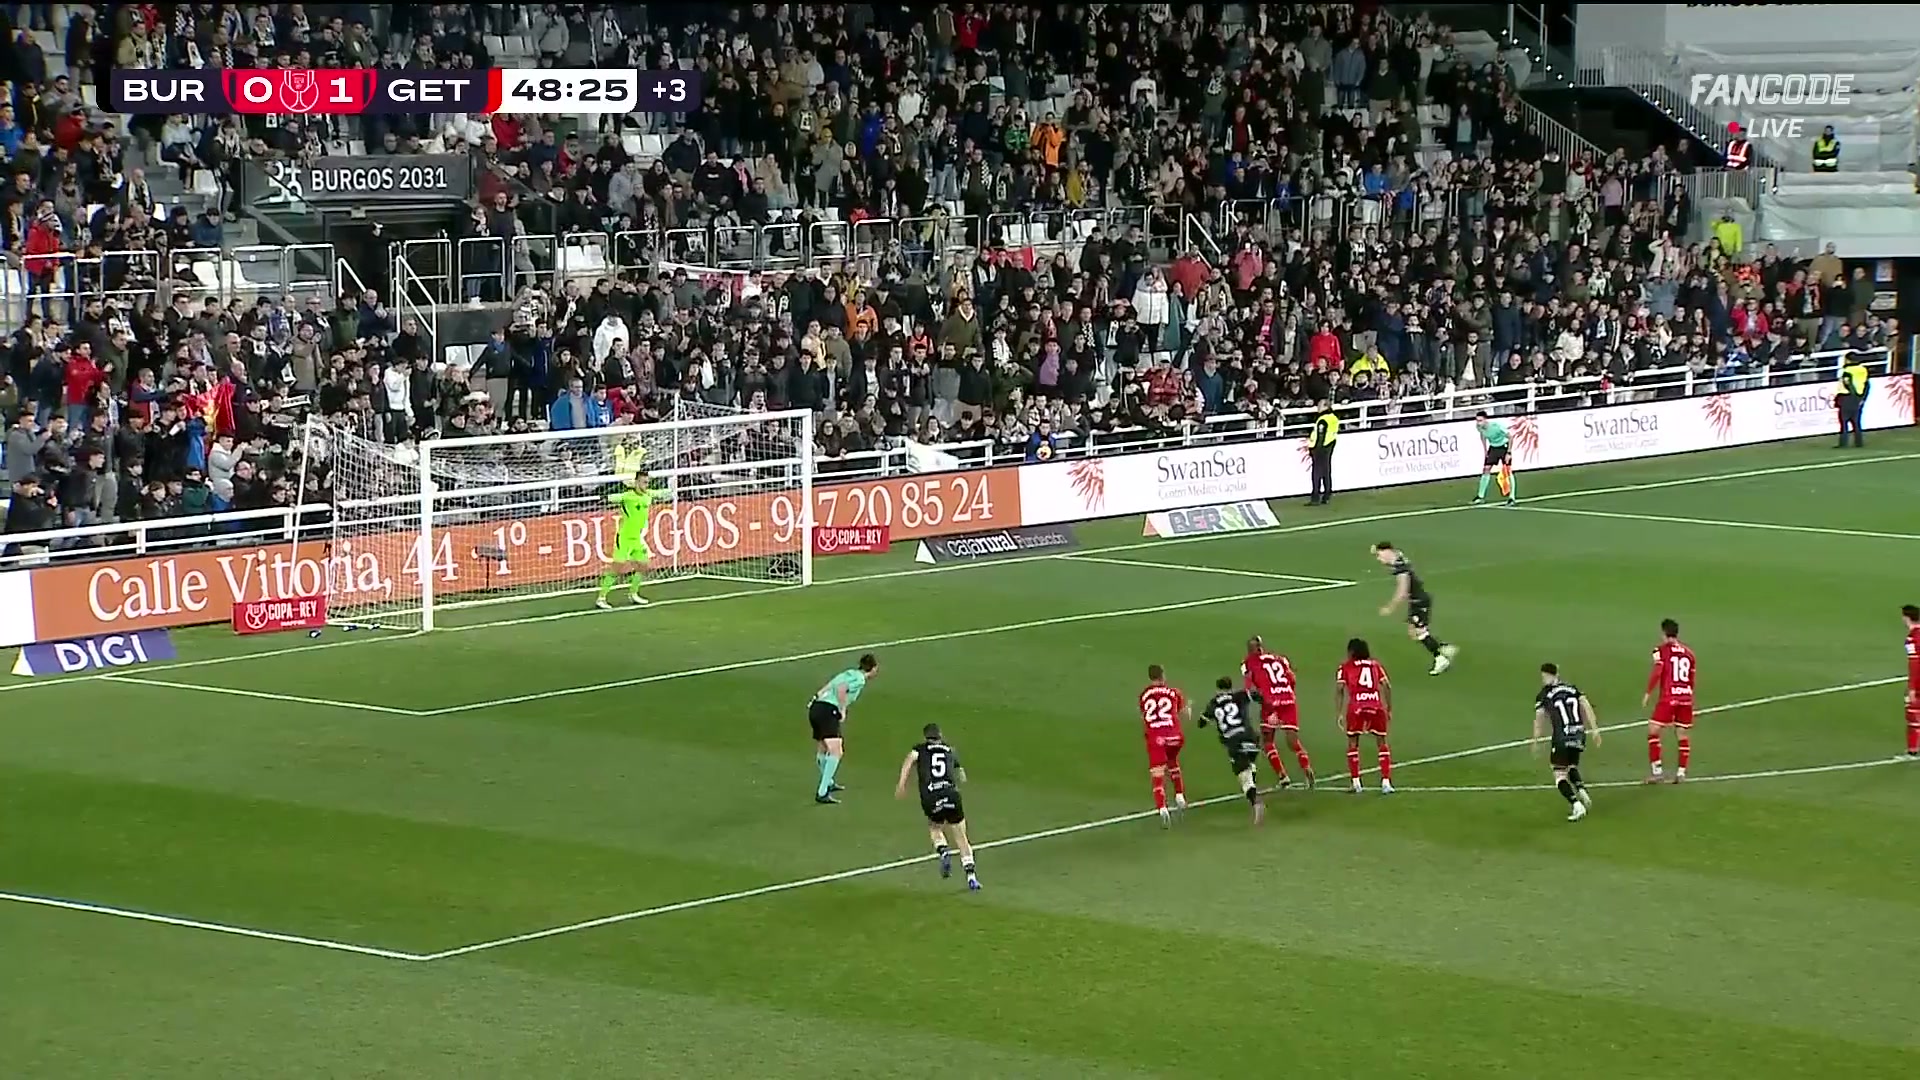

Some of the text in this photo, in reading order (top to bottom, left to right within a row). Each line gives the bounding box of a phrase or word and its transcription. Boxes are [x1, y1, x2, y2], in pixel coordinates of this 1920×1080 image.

[311, 167, 447, 191] BURGOS 2031
[1773, 386, 1835, 416] SwanSe
[1583, 408, 1658, 438] SwanSea
[1377, 428, 1459, 460] SwanSea
[1157, 450, 1246, 483] SwanSea
[87, 558, 209, 623] Calle
[216, 539, 392, 604] Vitoria,
[401, 531, 459, 585] 44
[846, 485, 893, 528] 20
[901, 478, 944, 529] 85
[950, 474, 994, 523] 24
[838, 528, 882, 545] COPA REY
[268, 600, 317, 621] COPA REY
[54, 633, 148, 674] DIGI
[1262, 661, 1288, 685] 12
[1358, 666, 1374, 689] 4
[1669, 656, 1691, 682] 18
[1144, 697, 1172, 722] 22
[1554, 697, 1580, 726] 17
[931, 752, 947, 778] 5
